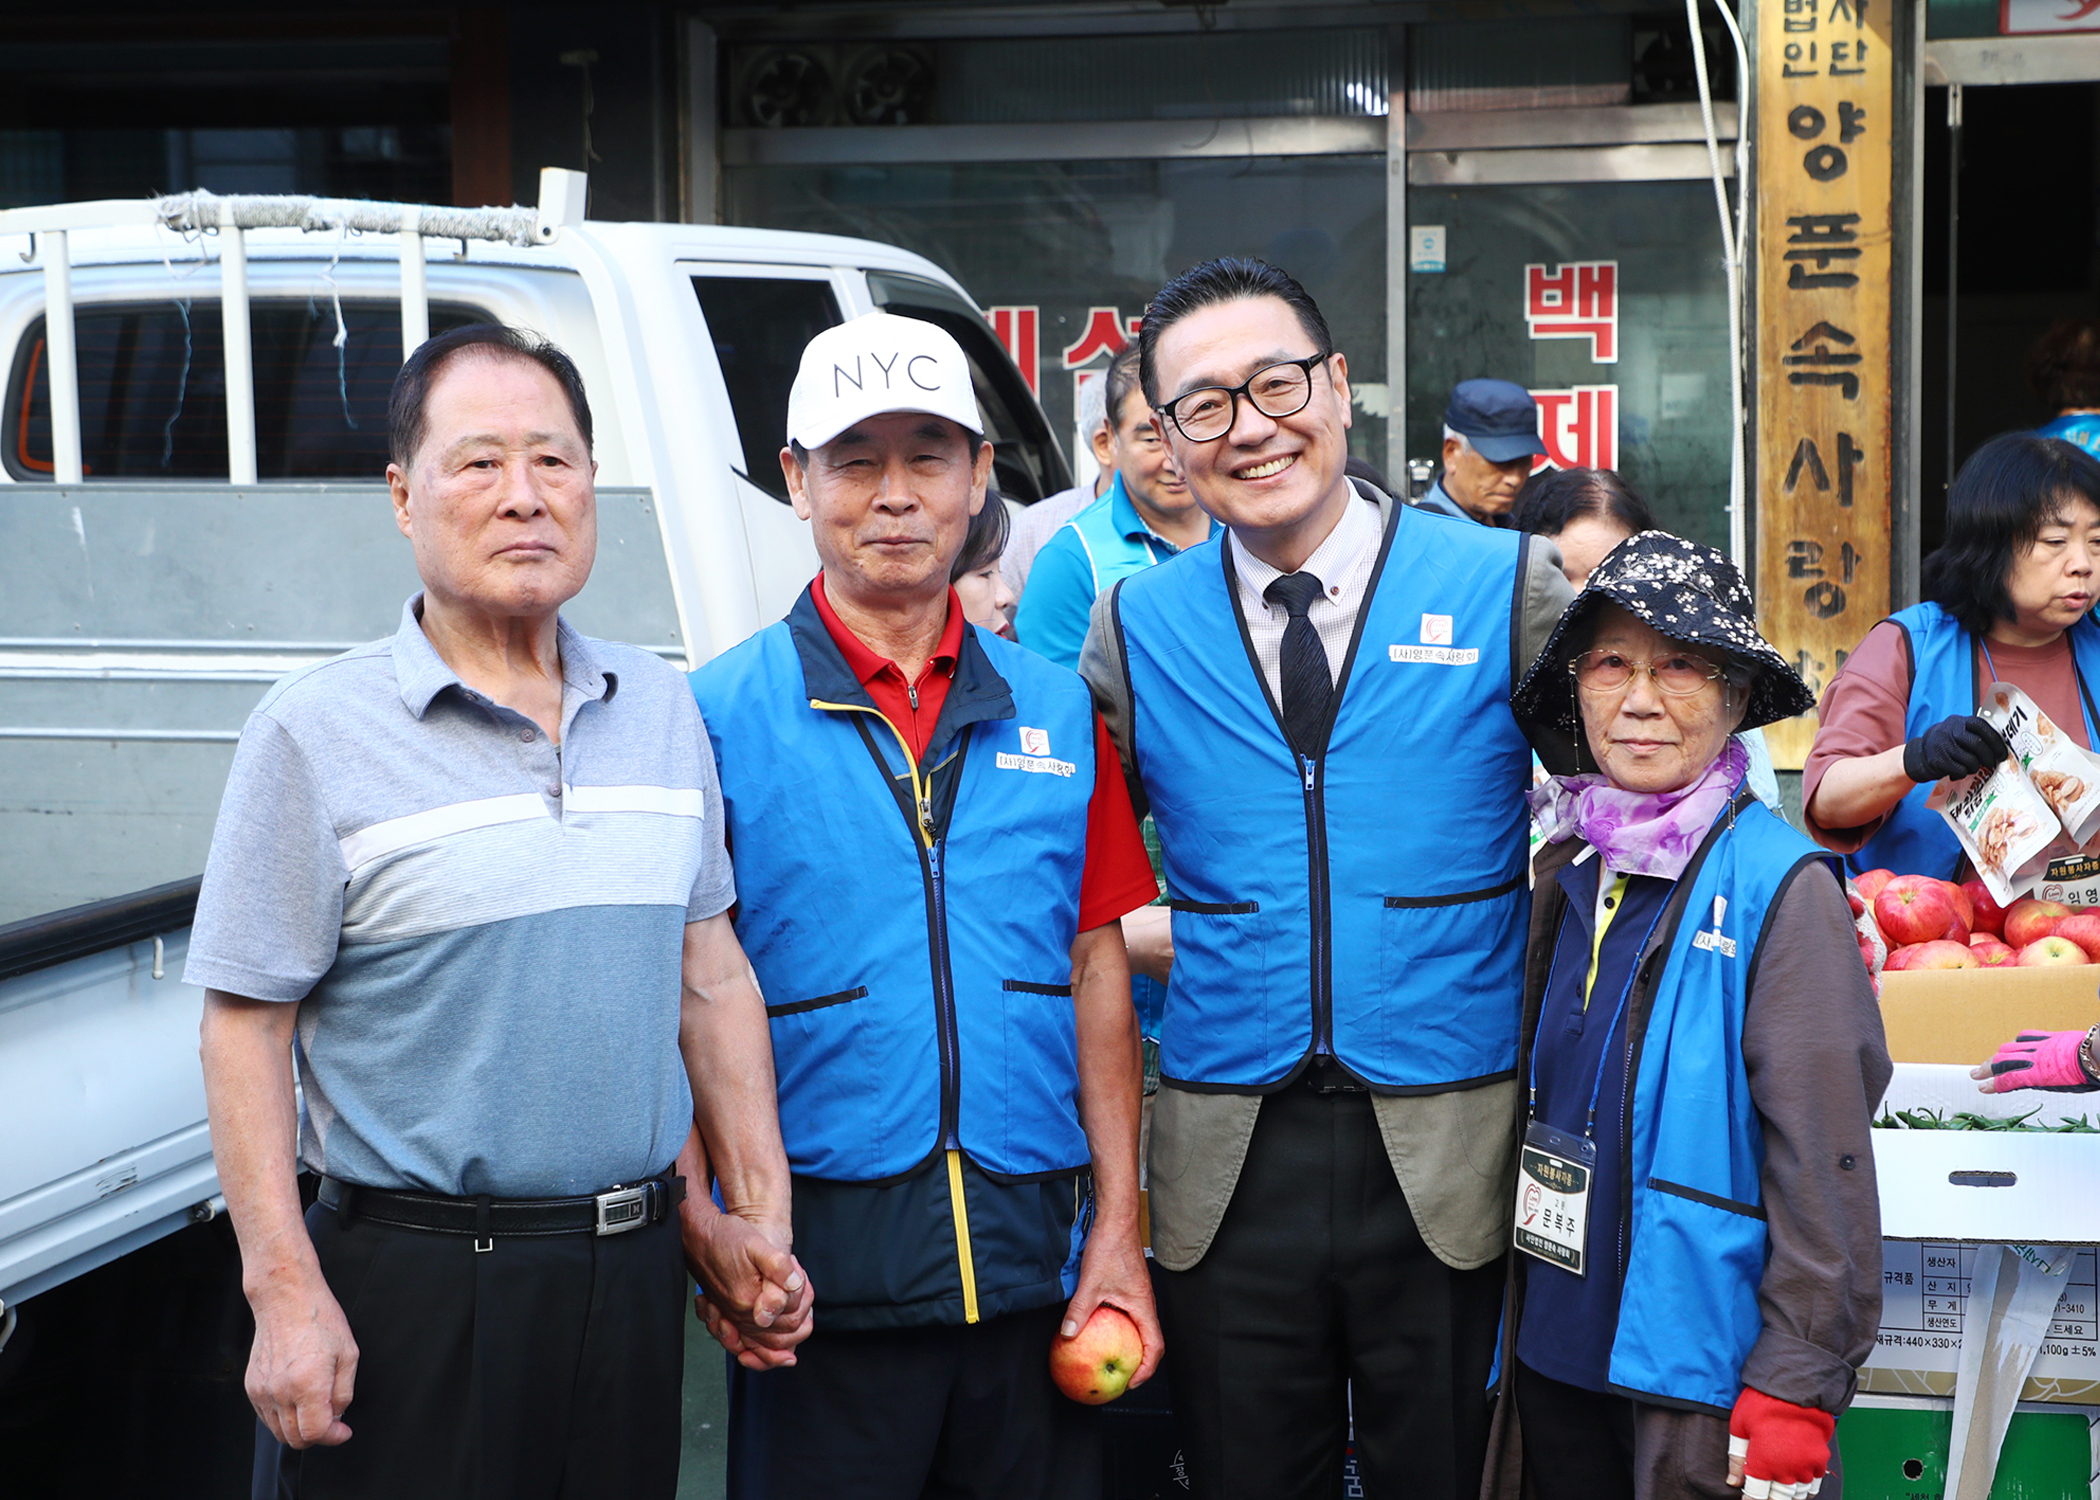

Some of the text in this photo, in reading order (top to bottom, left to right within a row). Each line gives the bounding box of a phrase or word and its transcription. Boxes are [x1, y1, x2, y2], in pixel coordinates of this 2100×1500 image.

[834, 352, 941, 398] NYC
[1927, 1256, 1956, 1269] 생산자
[1884, 1271, 1914, 1285] 규격품
[1927, 1317, 1957, 1328] 생산연도
[2054, 1324, 2083, 1335] 드세요
[2082, 1346, 2097, 1357] 5%
